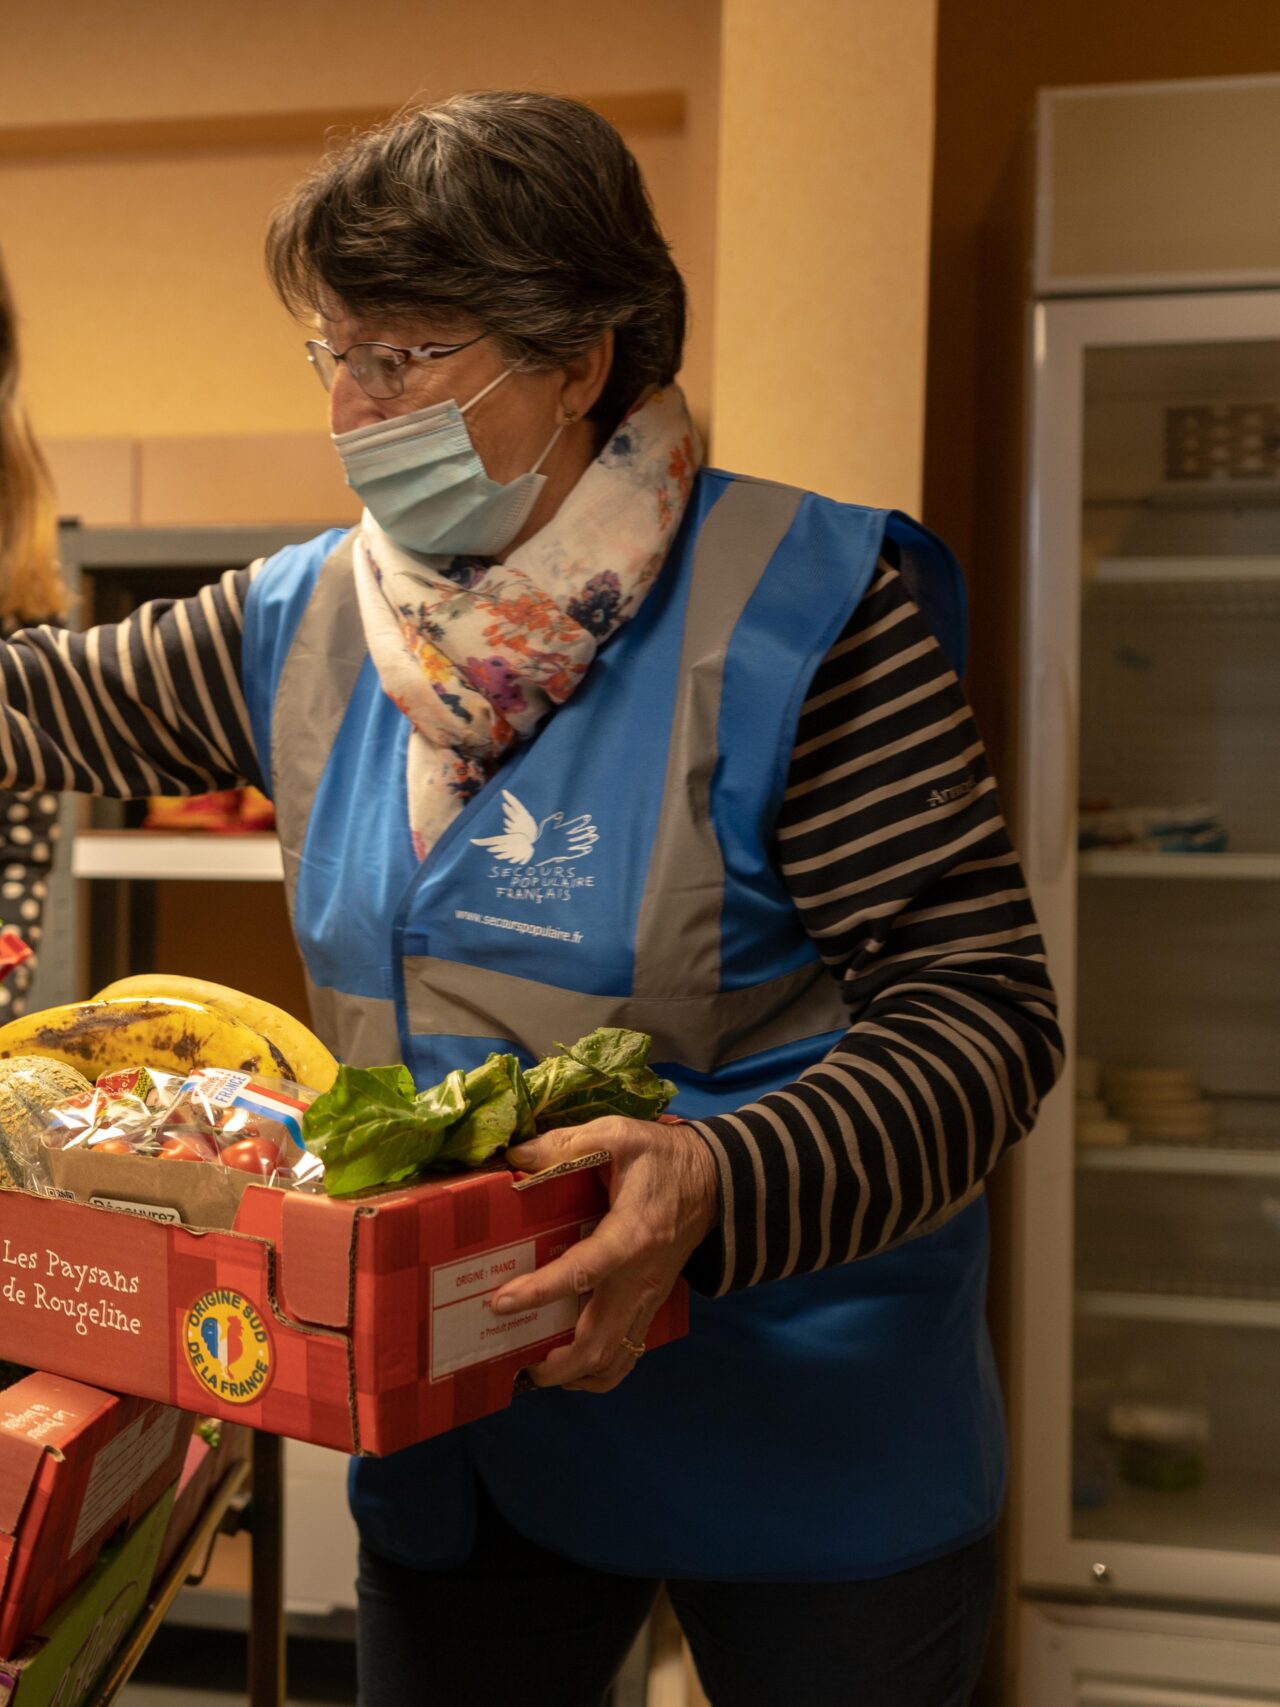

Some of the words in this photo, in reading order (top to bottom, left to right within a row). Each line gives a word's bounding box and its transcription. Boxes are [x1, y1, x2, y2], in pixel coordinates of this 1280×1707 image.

[488, 866, 577, 878] SECOURS
[510, 876, 595, 888] POPULAIRE
[495, 887, 571, 904] FRANÇAIS
[454, 909, 584, 944] www.secourspopulaire.fr
[215, 1075, 248, 1104] FRANCE
[2, 1239, 38, 1269] Les
[45, 1249, 140, 1293] Paysans
[455, 1271, 485, 1288] ORIGINE
[490, 1259, 517, 1277] FRANCE
[2, 1276, 26, 1305] de
[33, 1282, 141, 1336] Rougeline
[188, 1289, 242, 1328] ORIGINE
[242, 1305, 268, 1343] SUD
[188, 1341, 205, 1367] DE
[200, 1366, 218, 1389] LA
[220, 1359, 269, 1398] FRANCE
